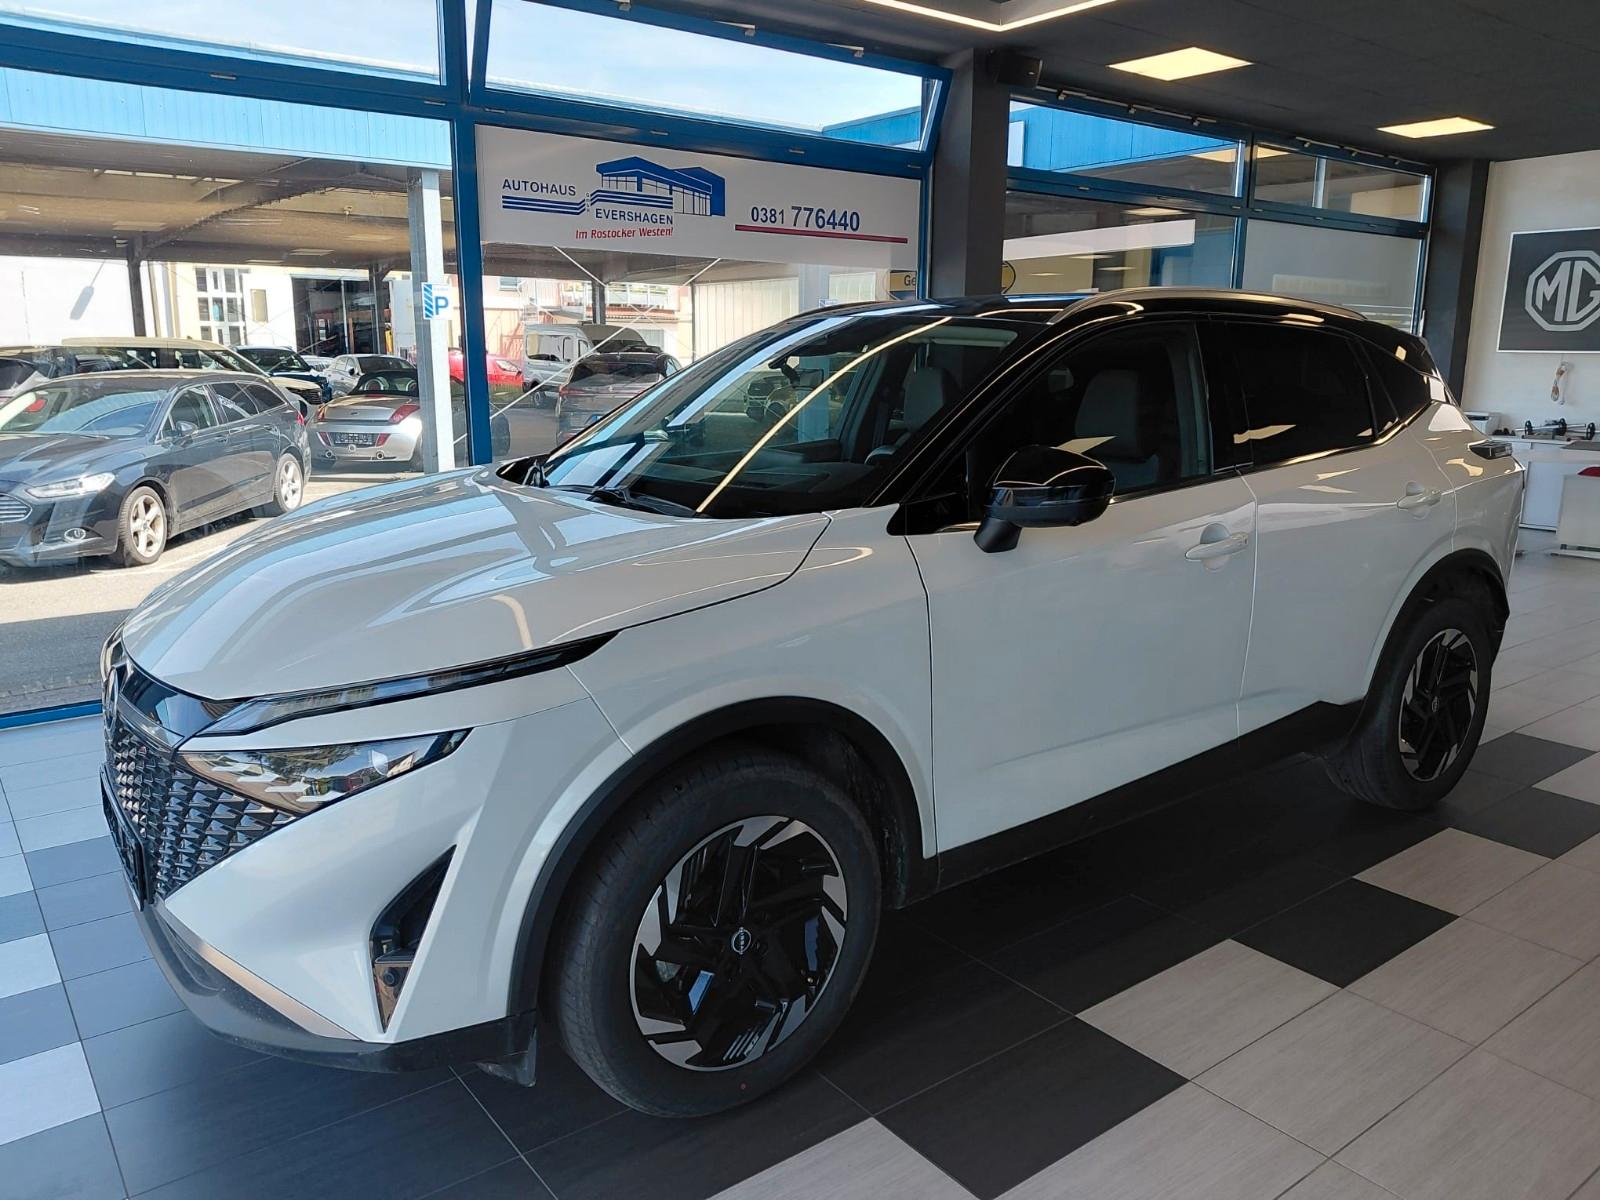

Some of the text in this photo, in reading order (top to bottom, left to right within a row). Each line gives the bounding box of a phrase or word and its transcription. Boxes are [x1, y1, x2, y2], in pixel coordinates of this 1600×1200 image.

[502, 178, 576, 196] AUTOHAUS
[595, 208, 673, 225] EVERSHAGEN
[751, 205, 860, 231] 0381 776440
[575, 227, 674, 240] Im Rostocker Westen!
[904, 274, 916, 286] Ge
[1535, 260, 1600, 322] MG
[434, 296, 449, 316] P
